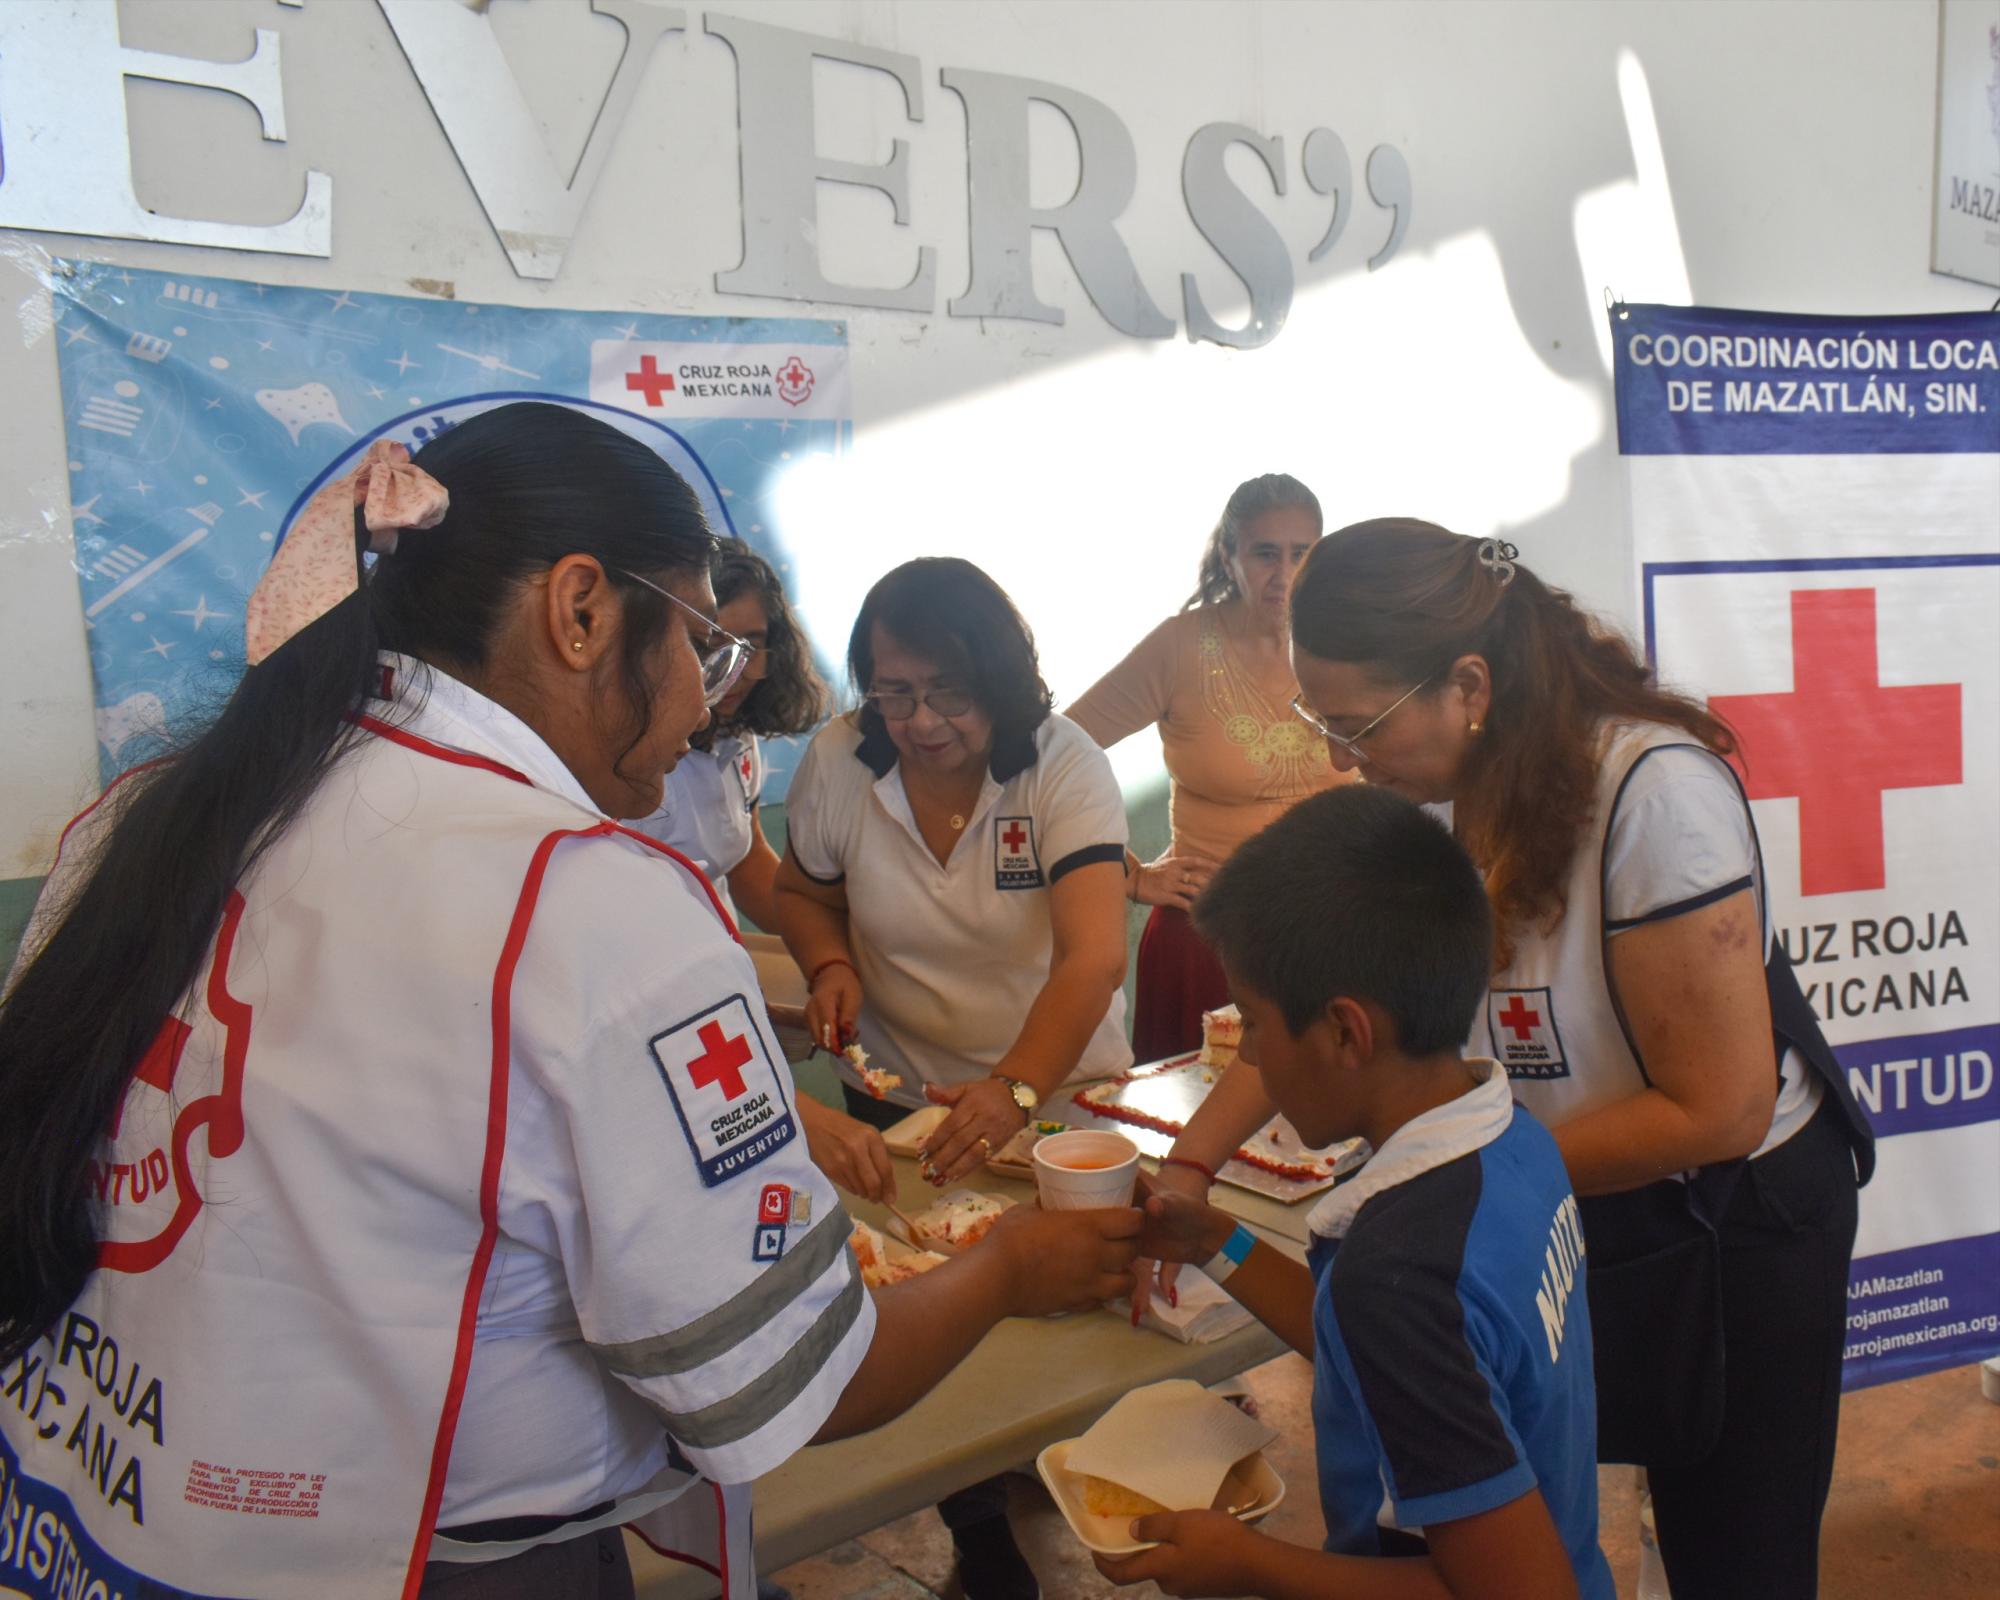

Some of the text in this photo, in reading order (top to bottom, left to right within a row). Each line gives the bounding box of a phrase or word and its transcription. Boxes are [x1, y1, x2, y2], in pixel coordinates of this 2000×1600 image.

[1629, 331, 2000, 370] COORDINACIÓN LOCA
[679, 364, 772, 380] CRUZ ROJA
[682, 383, 773, 398] MEXICANA
[1667, 374, 1987, 418] DE MAZATLÁN, SIN.
[1852, 910, 1968, 958] ROJA
[711, 1092, 770, 1131] CRUZ ROJA
[715, 1106, 775, 1147] MEXICANA
[714, 1123, 788, 1176] JUVENTUD
[59, 1311, 164, 1447] ROJA
[0, 1350, 144, 1526] XICANA
[188, 1477, 237, 1493] ELEMENTOS
[268, 1490, 291, 1498] CRUZ
[299, 1492, 321, 1500] ROJA
[190, 1468, 323, 1491] PARA USO EXCLUSIVO DE
[192, 1460, 327, 1482] EMBLEMA PROTEGIDO POR LEY
[184, 1494, 209, 1506] VENTA
[209, 1500, 238, 1511] FUERA
[242, 1505, 254, 1513] DE
[268, 1509, 319, 1518] INSTITUCIÓN
[185, 1485, 229, 1501] PROHIBIDA
[231, 1495, 243, 1503] SU
